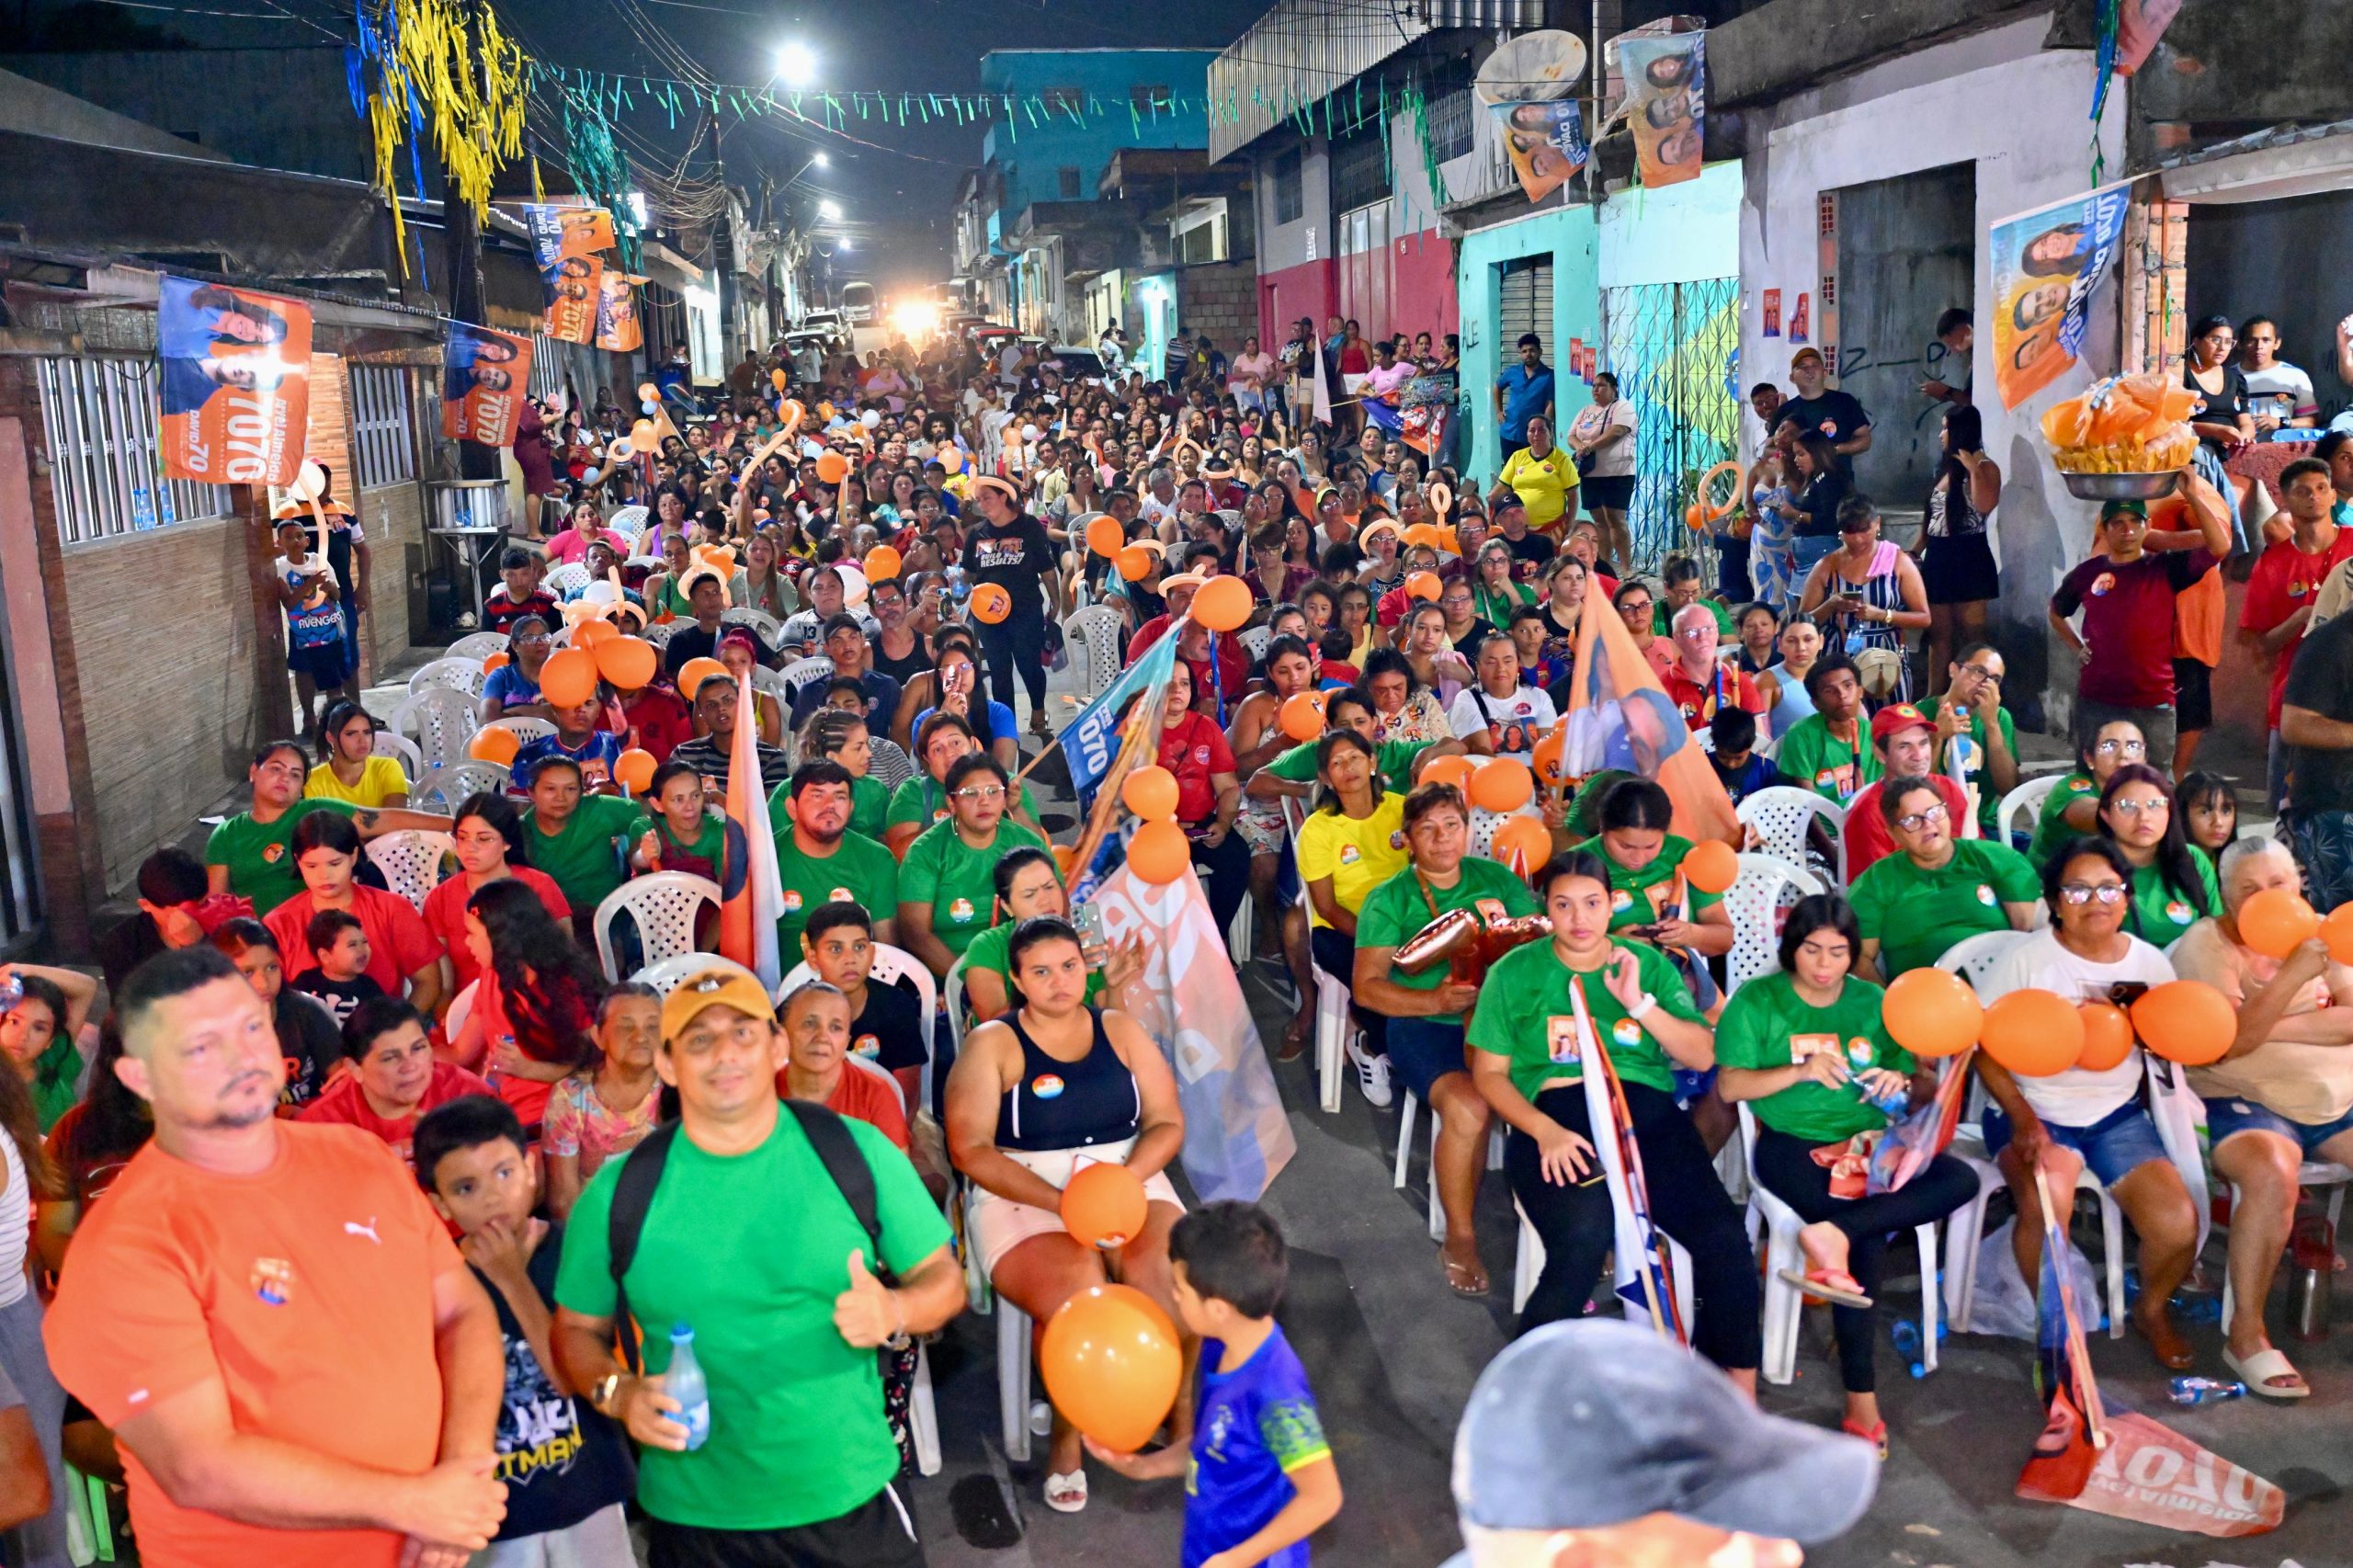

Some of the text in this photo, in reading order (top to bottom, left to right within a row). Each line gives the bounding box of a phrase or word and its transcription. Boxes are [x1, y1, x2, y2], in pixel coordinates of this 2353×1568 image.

[561, 301, 581, 341] 7070
[458, 416, 468, 434] 70
[476, 392, 505, 444] 7070
[188, 409, 209, 473] DAVID 70
[226, 397, 273, 481] 7070
[981, 557, 1023, 568] RESULTS!
[298, 611, 343, 629] AVENGERS
[803, 626, 816, 640] 13
